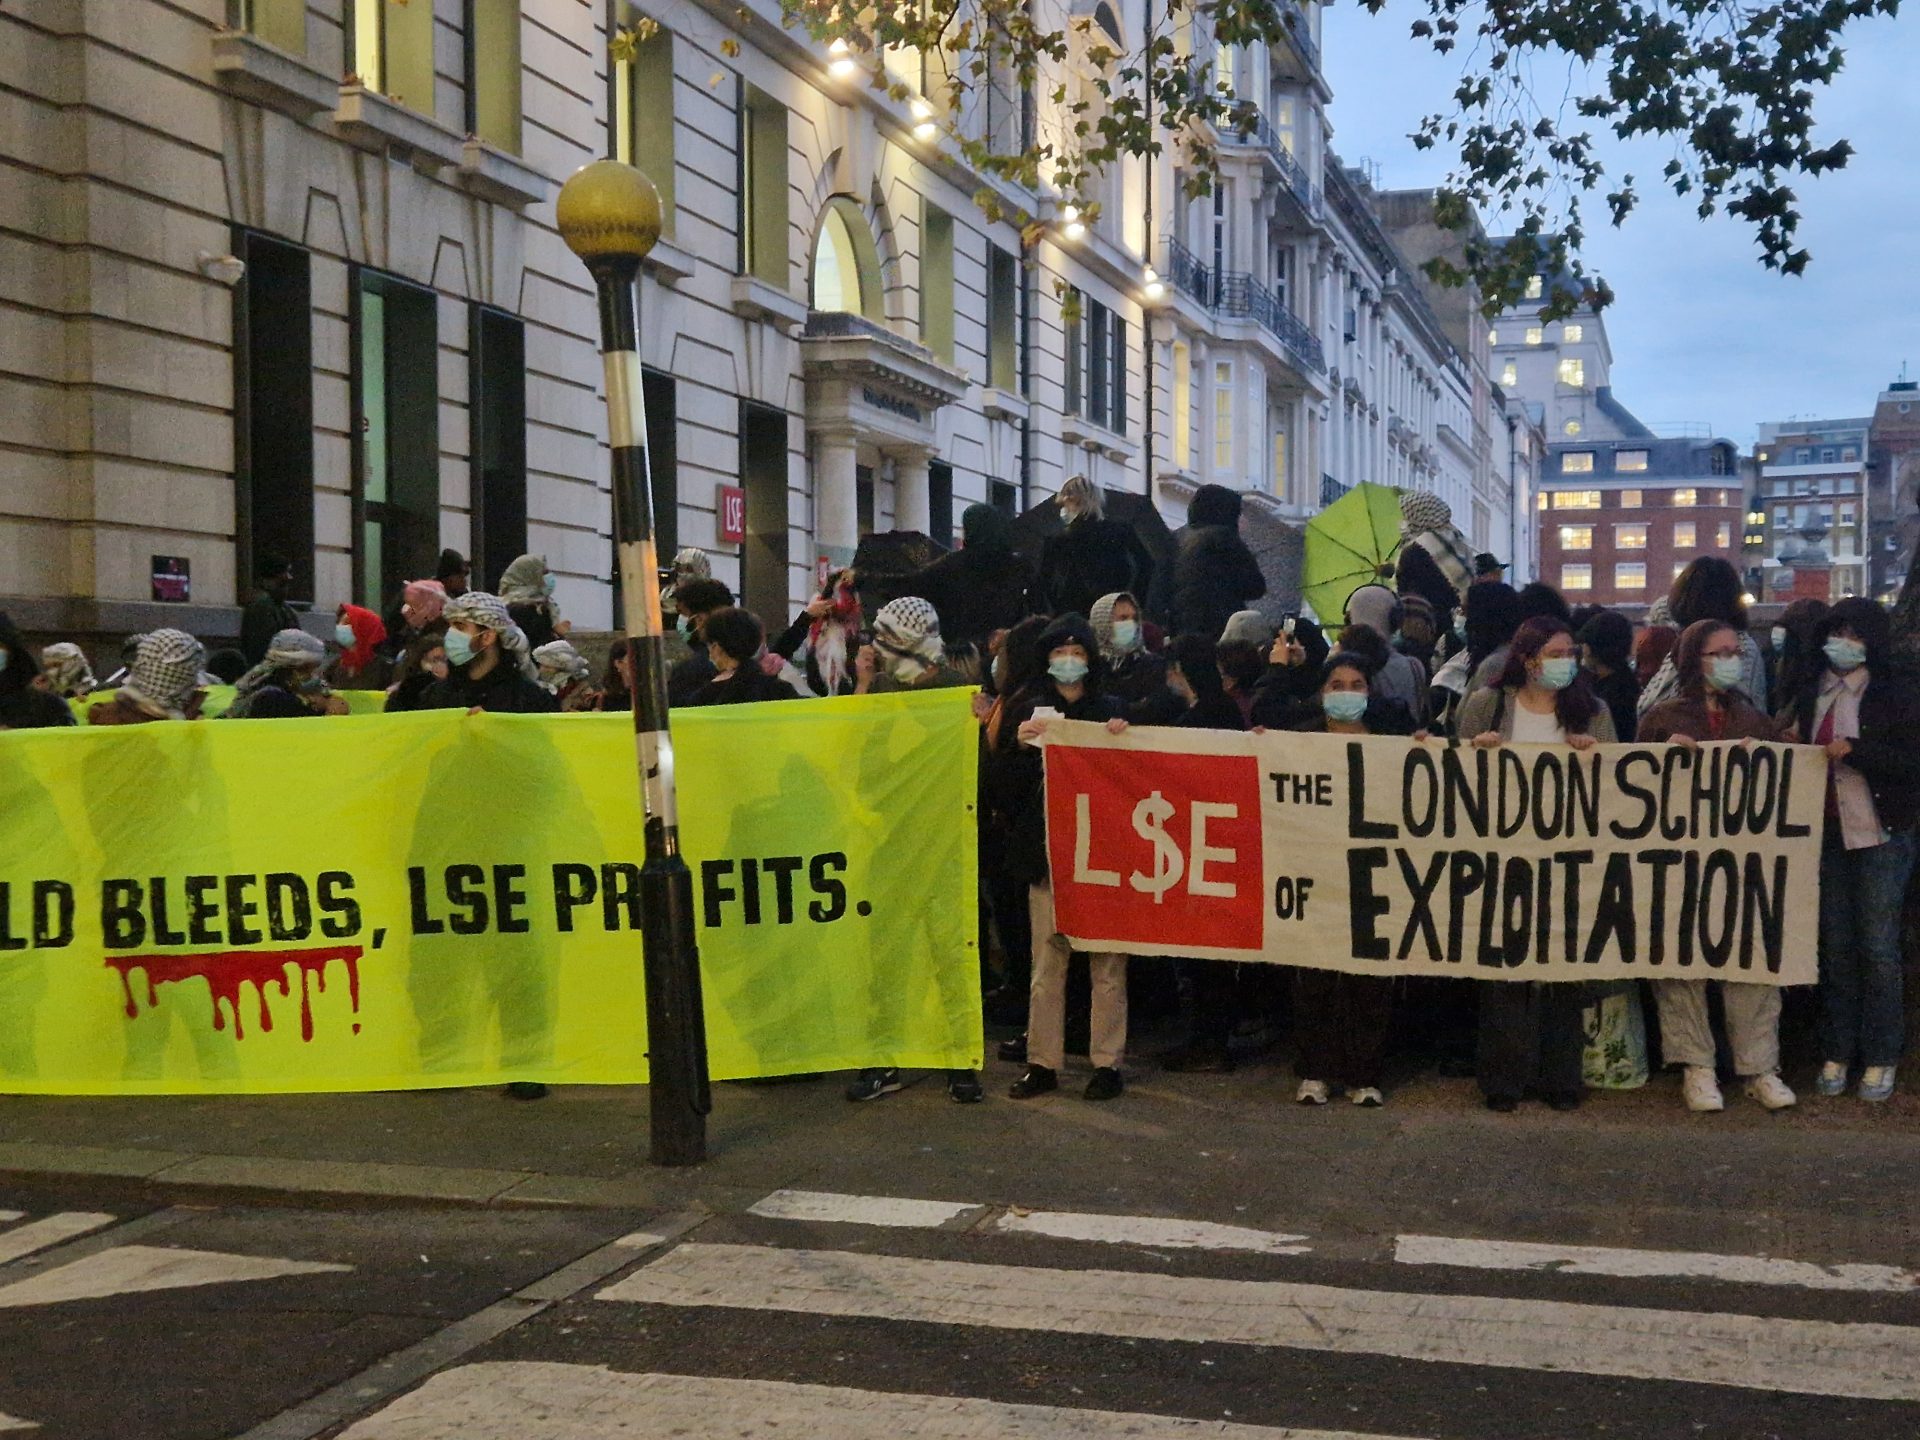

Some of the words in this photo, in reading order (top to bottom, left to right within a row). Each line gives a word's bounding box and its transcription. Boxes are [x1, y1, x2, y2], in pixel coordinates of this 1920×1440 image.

[726, 495, 742, 533] LSE
[1269, 772, 1333, 806] THE
[1346, 741, 1601, 840] LONDON
[1609, 745, 1811, 840] SCHOOL
[1073, 790, 1239, 904] L$E
[101, 870, 388, 949] BLEEDS,
[408, 863, 530, 935] LSE
[552, 851, 873, 932] PRFITS.
[1275, 876, 1314, 921] OF
[1347, 846, 1789, 974] EXPLOITATION
